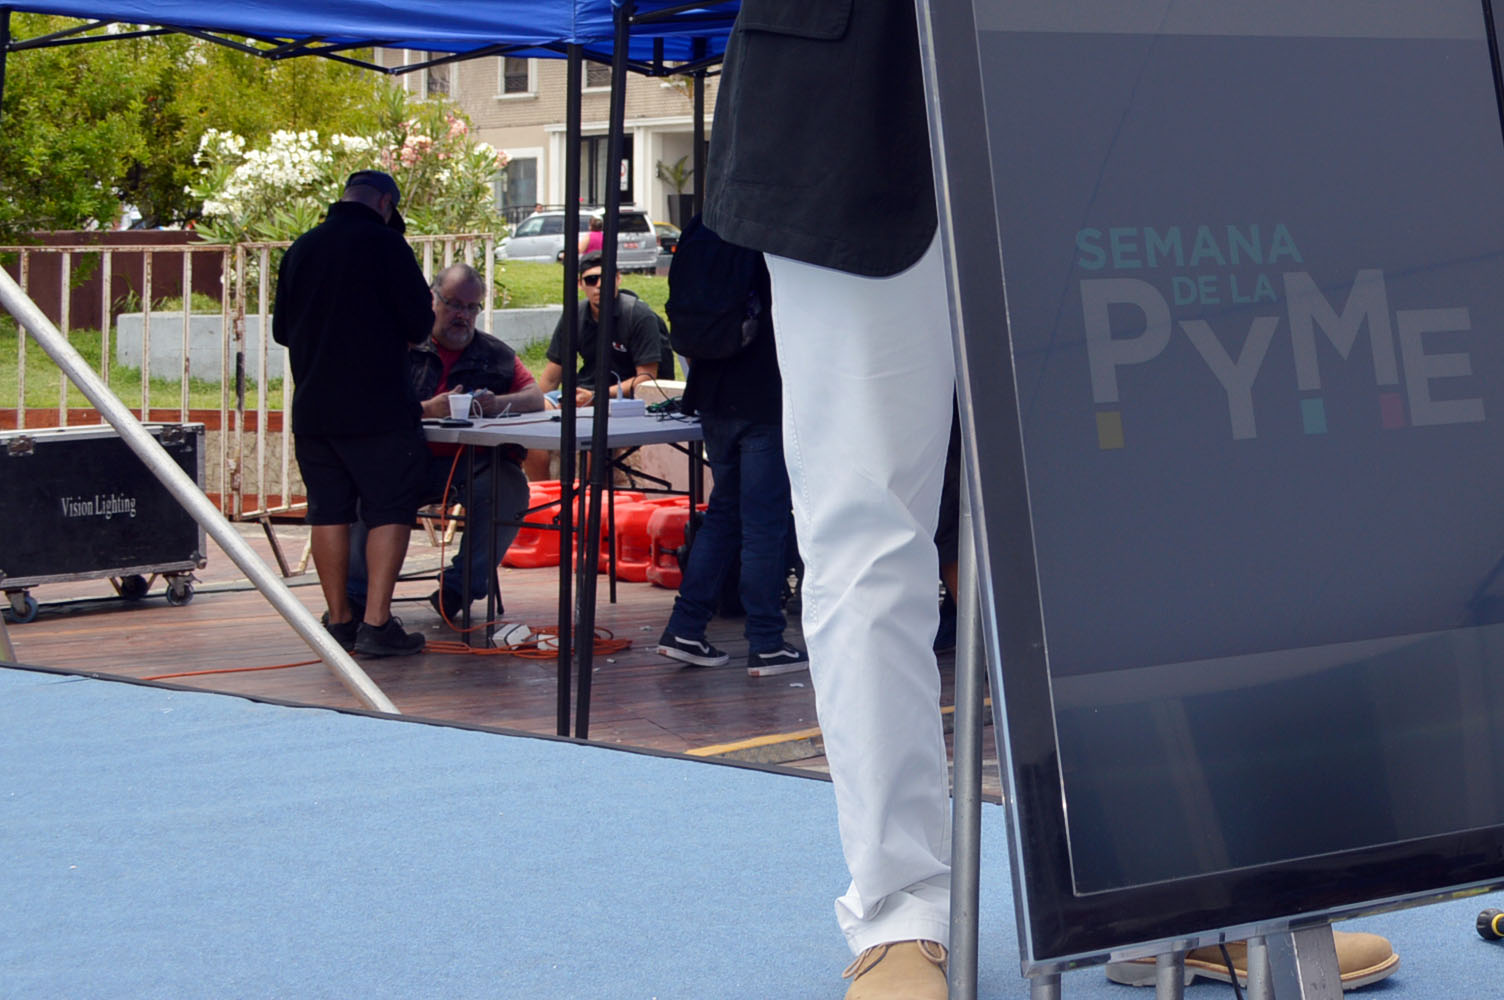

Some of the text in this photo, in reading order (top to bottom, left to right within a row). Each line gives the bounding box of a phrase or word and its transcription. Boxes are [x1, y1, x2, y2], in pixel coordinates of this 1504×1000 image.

[1075, 223, 1305, 270] SEMANA
[1172, 272, 1279, 306] DE LA
[1079, 268, 1487, 441] PYME
[61, 493, 136, 520] Vision Lighting
